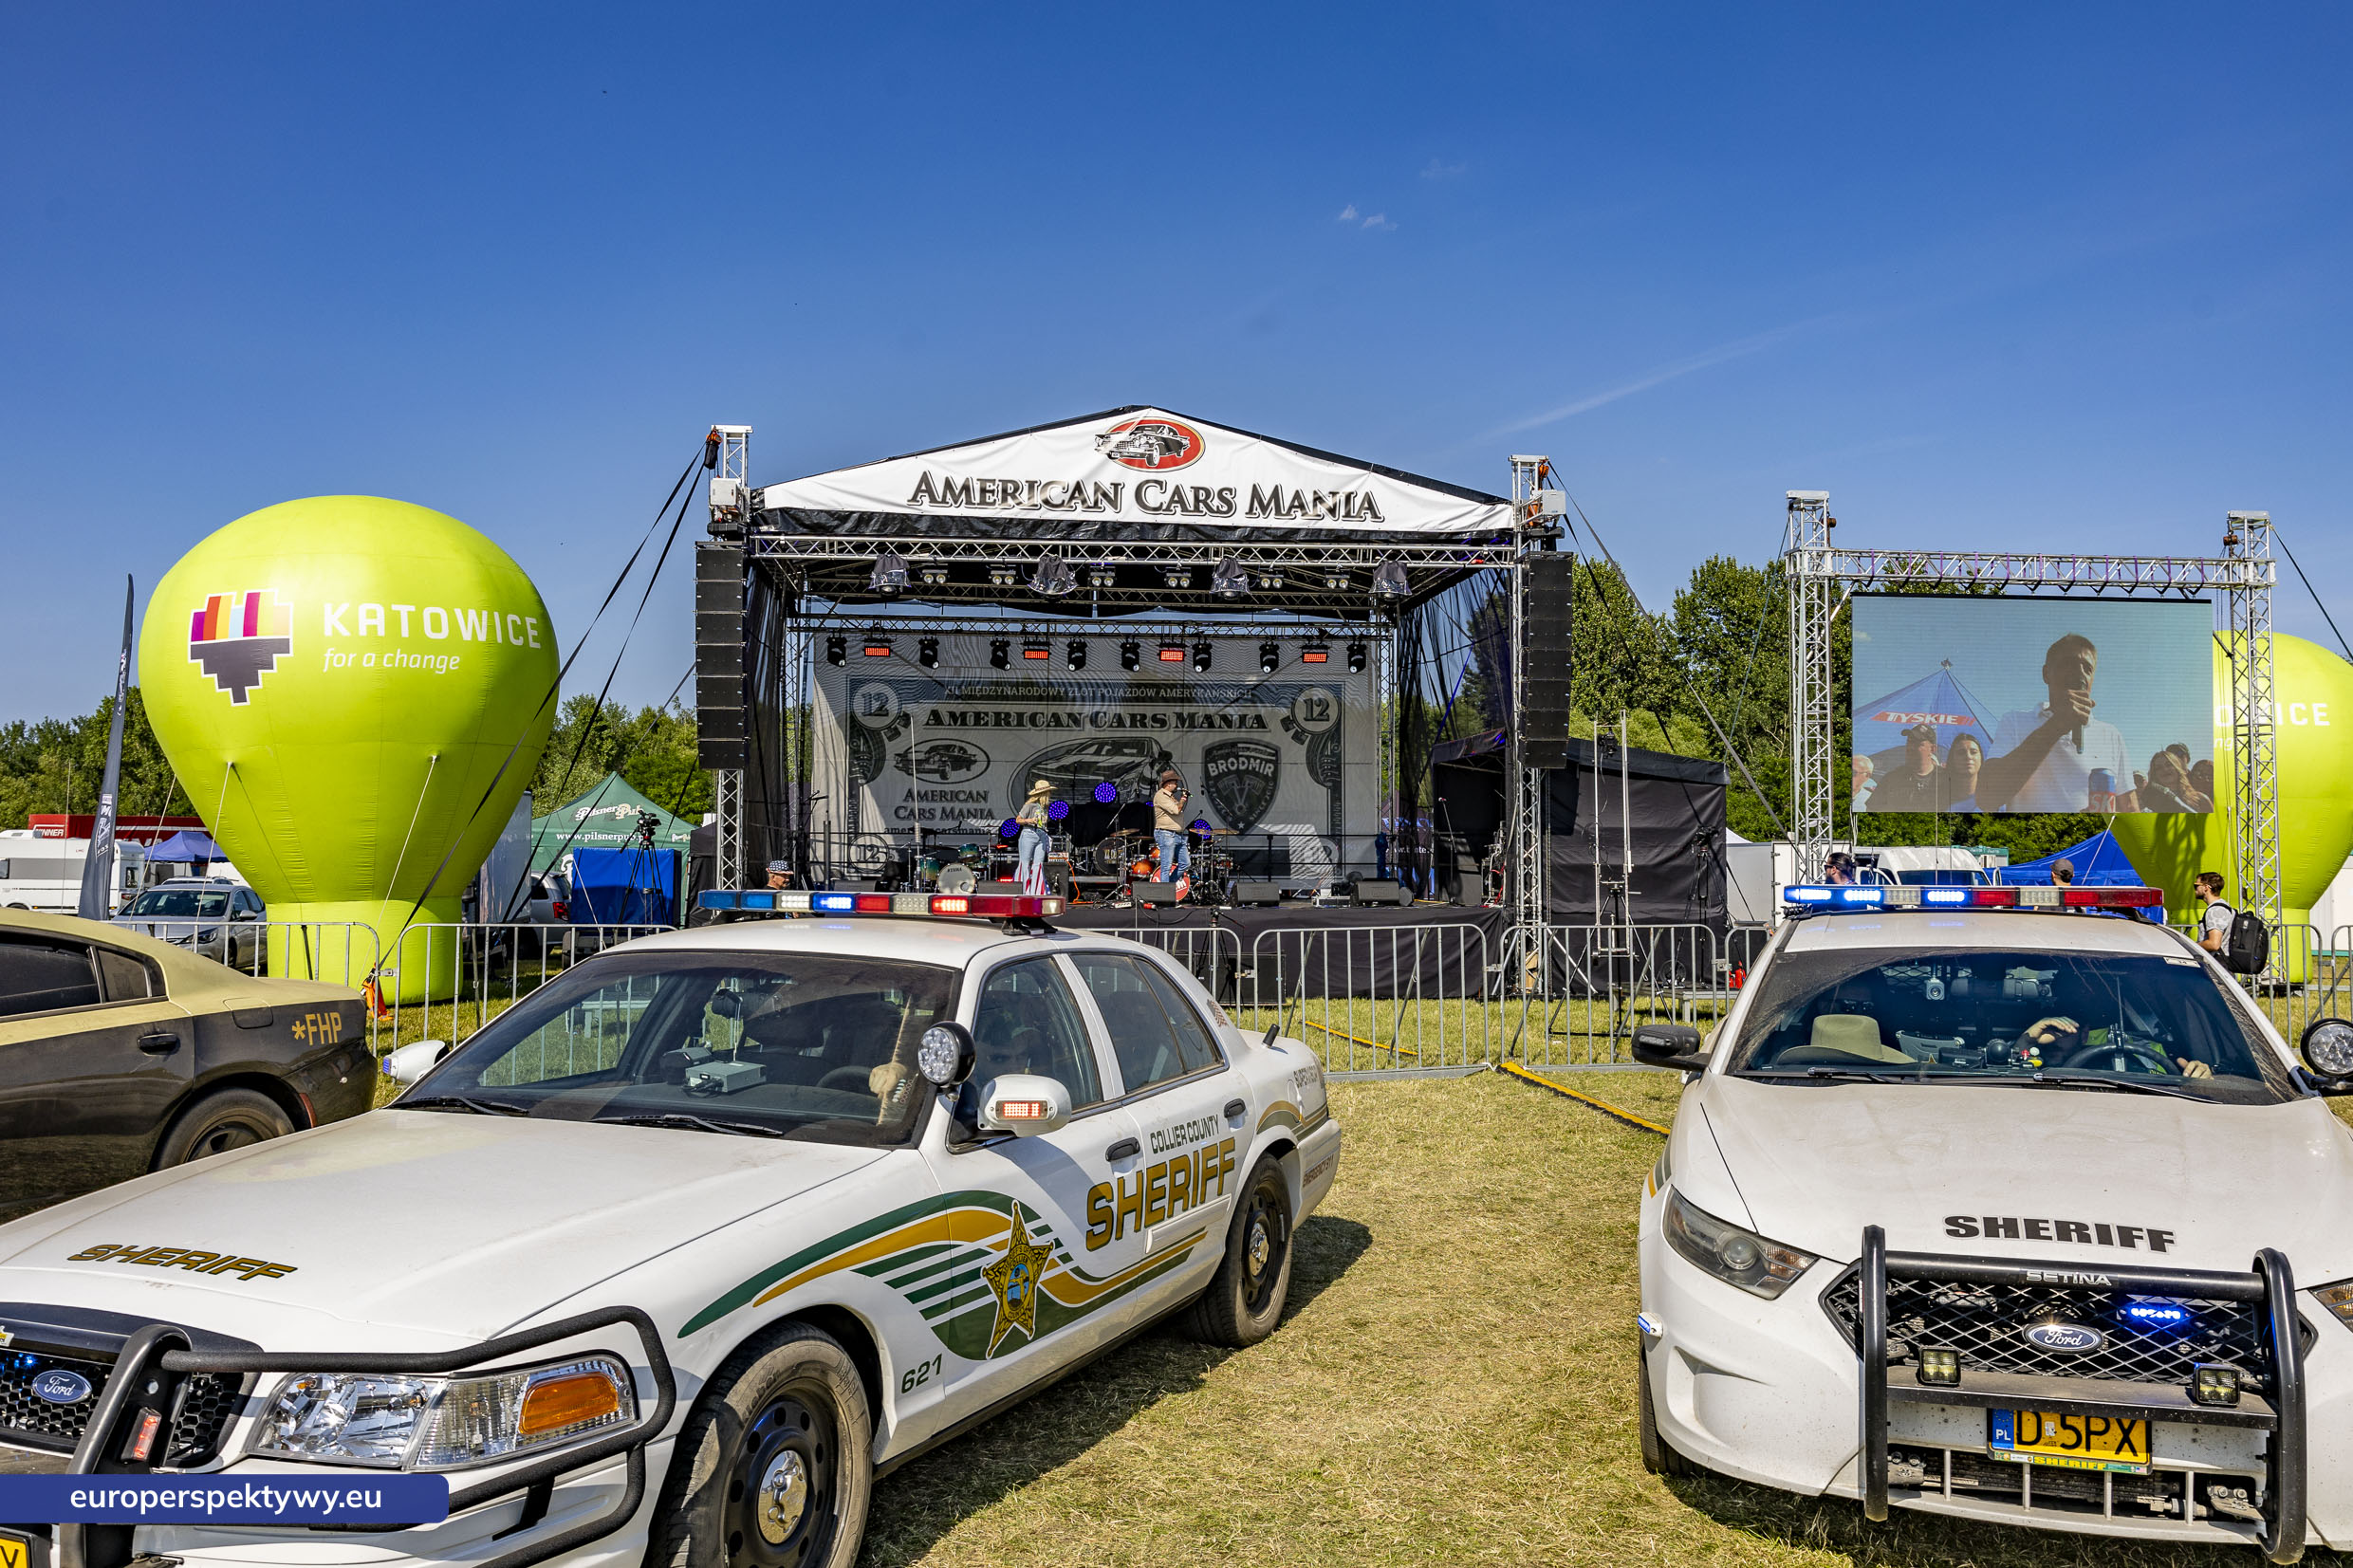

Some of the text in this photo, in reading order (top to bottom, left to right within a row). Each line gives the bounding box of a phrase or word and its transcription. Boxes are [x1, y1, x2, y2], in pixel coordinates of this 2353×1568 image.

[907, 470, 1384, 522] AMERICAN CARS MANIA
[324, 602, 542, 649] KATOWICE
[323, 647, 461, 673] for a change
[862, 692, 890, 716] 12
[1303, 697, 1330, 722] 12
[922, 709, 1271, 732] AMERICAN CARS MANIA
[1886, 711, 1959, 725] TYSKIE
[1208, 757, 1275, 777] BRODMIR
[903, 788, 990, 803] AMERICAN
[894, 805, 995, 821] CARS MANIA
[1150, 1115, 1219, 1153] COLLIER COUNTY
[1086, 1137, 1235, 1252] SHERIFF
[1944, 1215, 2176, 1252] SHERIFF
[66, 1244, 298, 1281] SHERIFF
[2026, 1270, 2112, 1286] SETINA
[2044, 1329, 2083, 1346] Ford
[901, 1353, 942, 1394] 621
[44, 1375, 76, 1397] Ford
[1995, 1429, 2011, 1441] PL
[2033, 1455, 2107, 1470] SHERIFF
